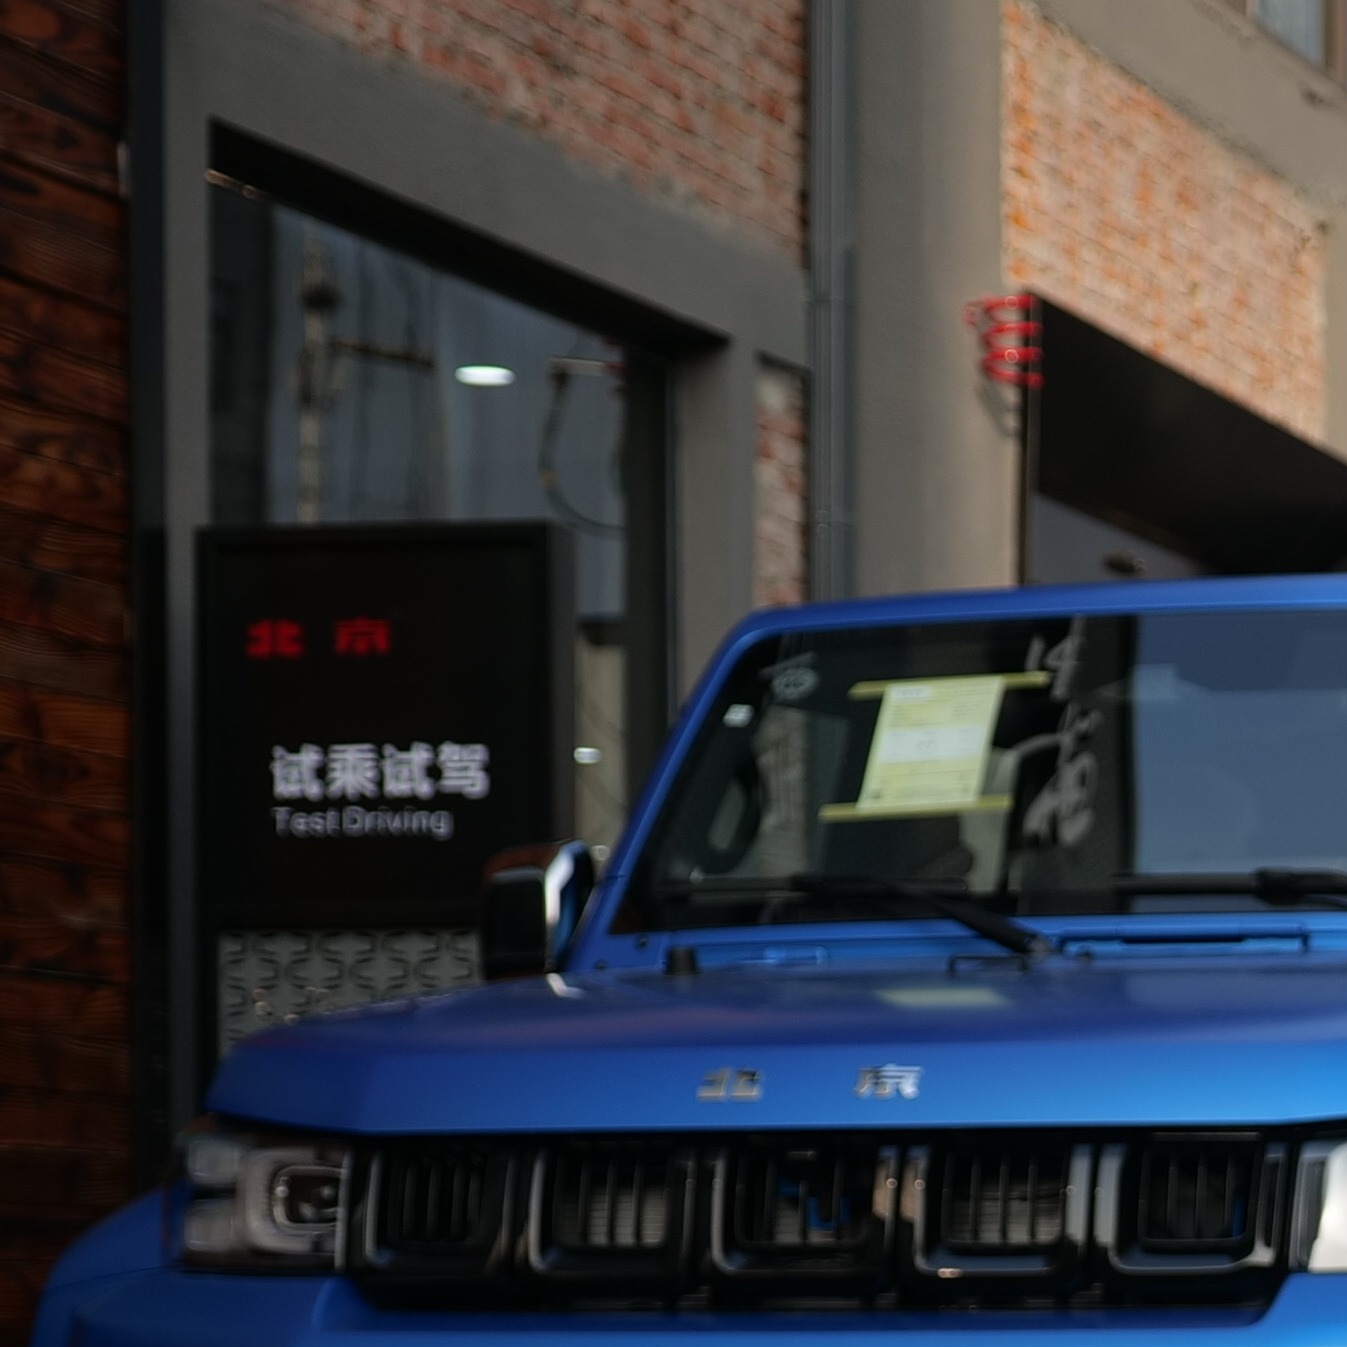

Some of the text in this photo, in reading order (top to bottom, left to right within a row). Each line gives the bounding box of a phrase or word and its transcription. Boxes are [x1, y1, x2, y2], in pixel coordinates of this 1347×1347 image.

[269, 740, 491, 802] 试乘试驾
[270, 805, 455, 841] Test Driving
